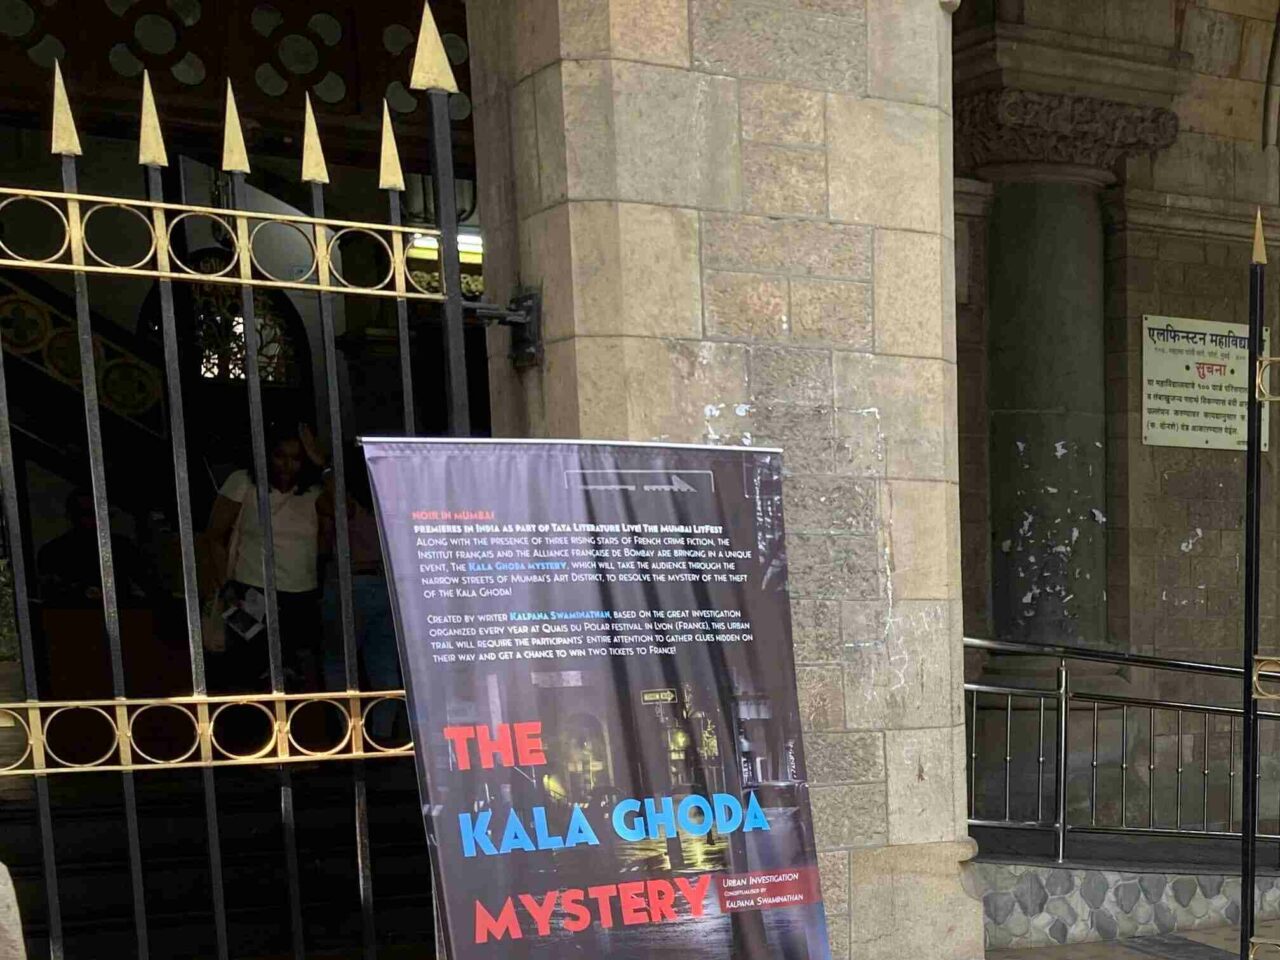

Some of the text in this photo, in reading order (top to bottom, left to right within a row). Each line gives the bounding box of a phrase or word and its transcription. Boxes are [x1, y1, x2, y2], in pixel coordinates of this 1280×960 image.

[1148, 324, 1266, 350] एलफिन्स्टन महाविद्या
[441, 511, 452, 519] IN
[454, 511, 495, 519] MUMBAI
[414, 523, 722, 534] PREMIERES IN INDIA AS PART OF TATA LITERATURE LIVE! THE MUMBAI LITFEST
[417, 538, 447, 546] ALONG
[450, 538, 470, 546] WITH
[474, 537, 488, 545] THE
[491, 537, 528, 545] PRESENCE
[545, 536, 568, 544] THREE
[571, 537, 595, 545] RISING
[597, 537, 618, 545] STARS
[634, 536, 661, 545] FRENCH
[663, 537, 685, 545] CRIME
[687, 538, 715, 546] FICTION,
[718, 538, 729, 546] THE
[451, 563, 466, 571] THE
[468, 563, 493, 571] KALA
[495, 562, 524, 570] GHODA
[572, 561, 596, 569] WHICH
[617, 561, 634, 569] TAKE
[637, 561, 649, 569] THE
[652, 561, 686, 569] AUDIENCE
[688, 561, 721, 570] THROUGH
[724, 562, 735, 570] THE
[424, 587, 512, 598] OF THE KALA GHODA!
[427, 614, 461, 623] CREATED
[464, 615, 474, 623] BY
[478, 614, 507, 622] WRITER
[510, 612, 549, 620] KALPANA
[551, 610, 612, 620] SWAMINATHAN,
[639, 610, 652, 618] ON
[653, 610, 664, 618] THE
[667, 610, 689, 618] GREAT
[443, 721, 547, 770] THE
[458, 791, 770, 857] KALA GHODA
[723, 873, 799, 887] URBAN INVESTIGATION
[726, 894, 803, 908] KALPANA SWAMINATHAN
[475, 875, 712, 943] MYSTERY
